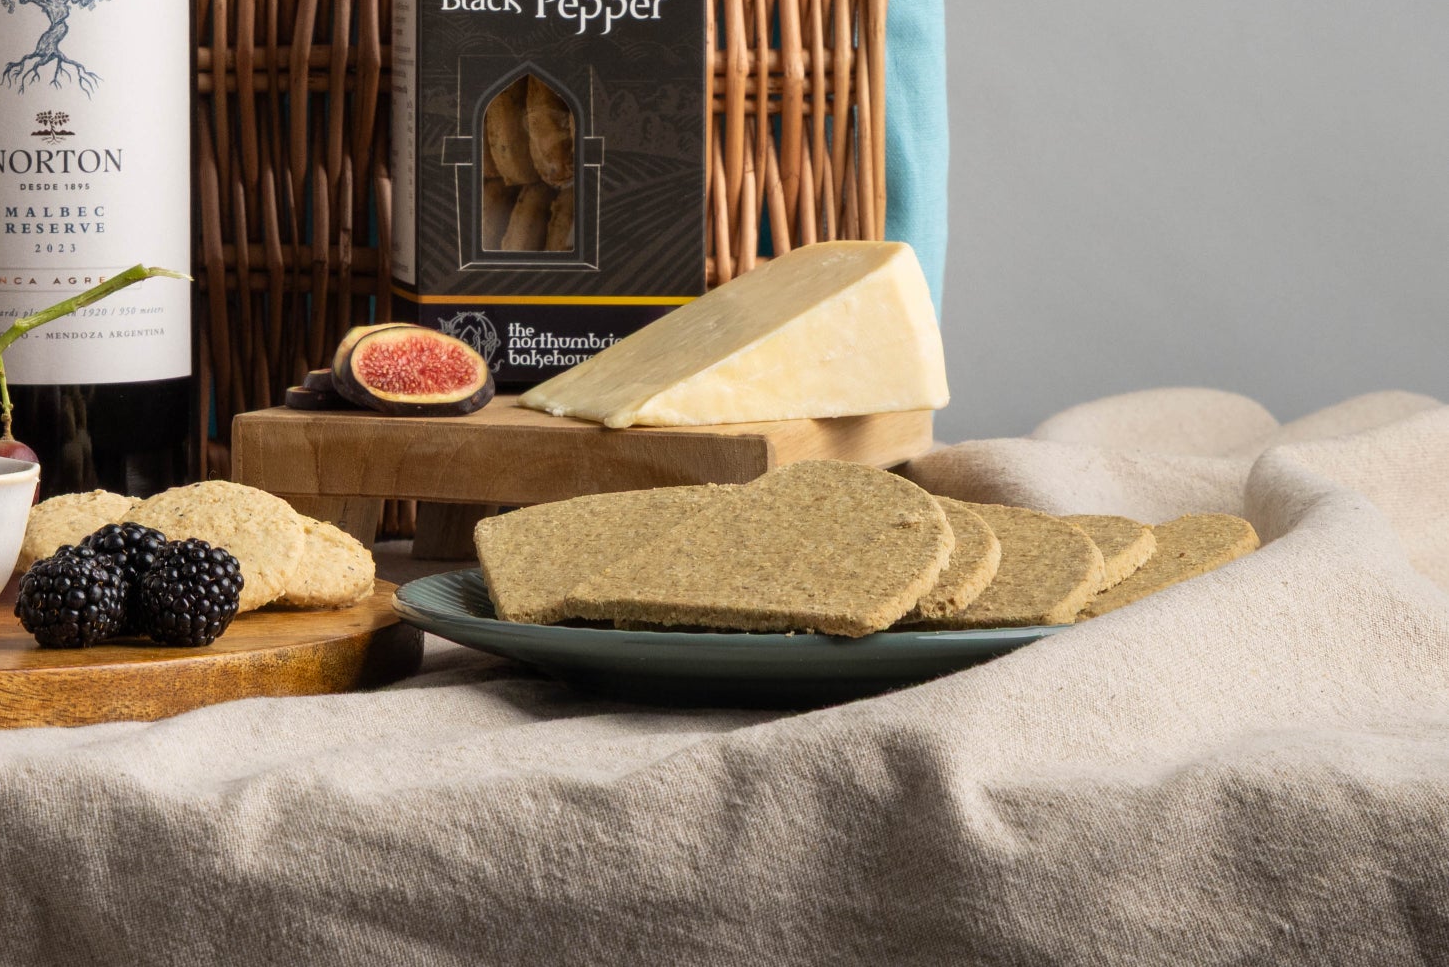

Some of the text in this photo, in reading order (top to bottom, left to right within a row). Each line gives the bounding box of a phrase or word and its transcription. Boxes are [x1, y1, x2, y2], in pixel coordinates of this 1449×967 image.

[19, 183, 91, 191] DESDE 1895
[5, 206, 105, 218] MALBEC
[5, 222, 105, 234] RESERVE
[34, 243, 77, 253] 2023
[507, 322, 535, 337] the
[45, 331, 103, 340] MENDOZA
